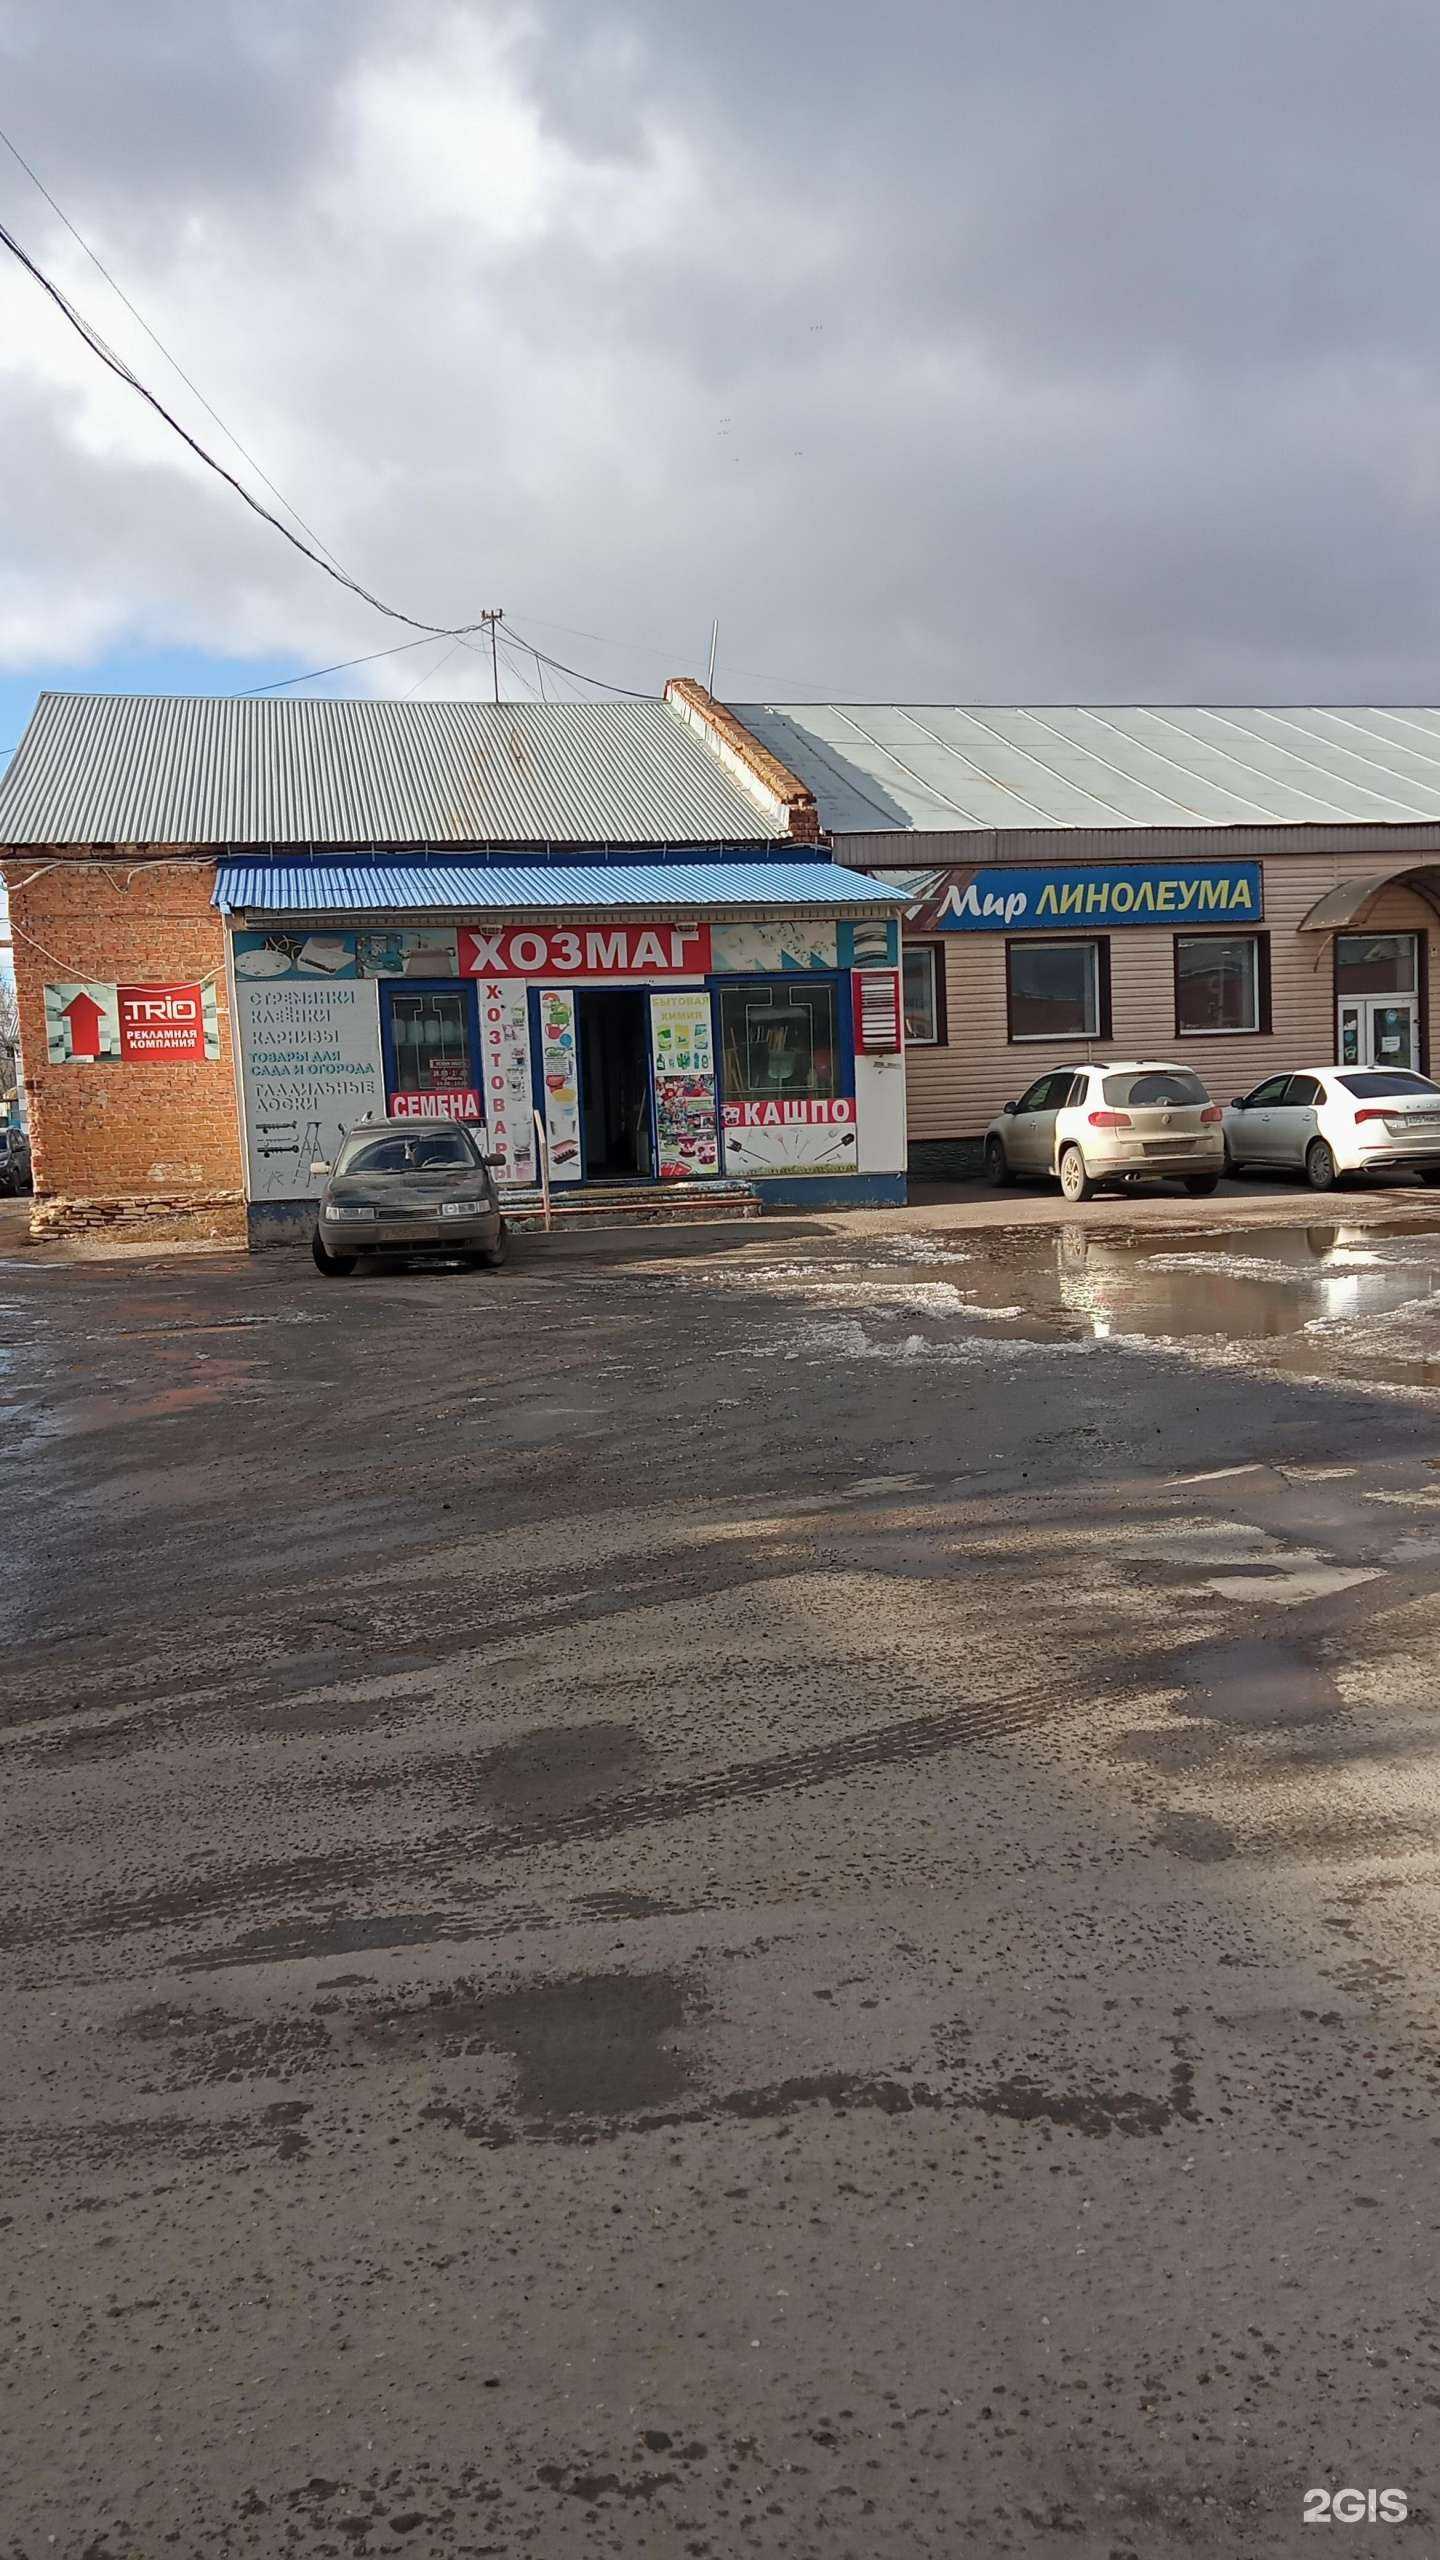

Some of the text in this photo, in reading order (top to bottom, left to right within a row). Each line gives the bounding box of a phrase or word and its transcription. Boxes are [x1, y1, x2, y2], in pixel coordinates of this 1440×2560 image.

[937, 879, 1252, 924] Мир ЛИНОЛЕУМА
[469, 931, 699, 971] ХОЗМАГ
[126, 1030, 197, 1039] РЕКЛАМНАЯ
[252, 1030, 340, 1044] КАРНИЗЫ
[130, 1039, 195, 1048] КОМПАНИЯ
[249, 1051, 340, 1062] ТОВАРЫ ДЛЯ
[251, 1063, 375, 1076] САДА И ОГОРОДА
[255, 1081, 375, 1097] ГЛАДИЛЬНЫЕ
[256, 1098, 318, 1112] ДОСКИ
[393, 1094, 479, 1118] СЕМЕНА
[745, 1100, 850, 1125] КАШПО
